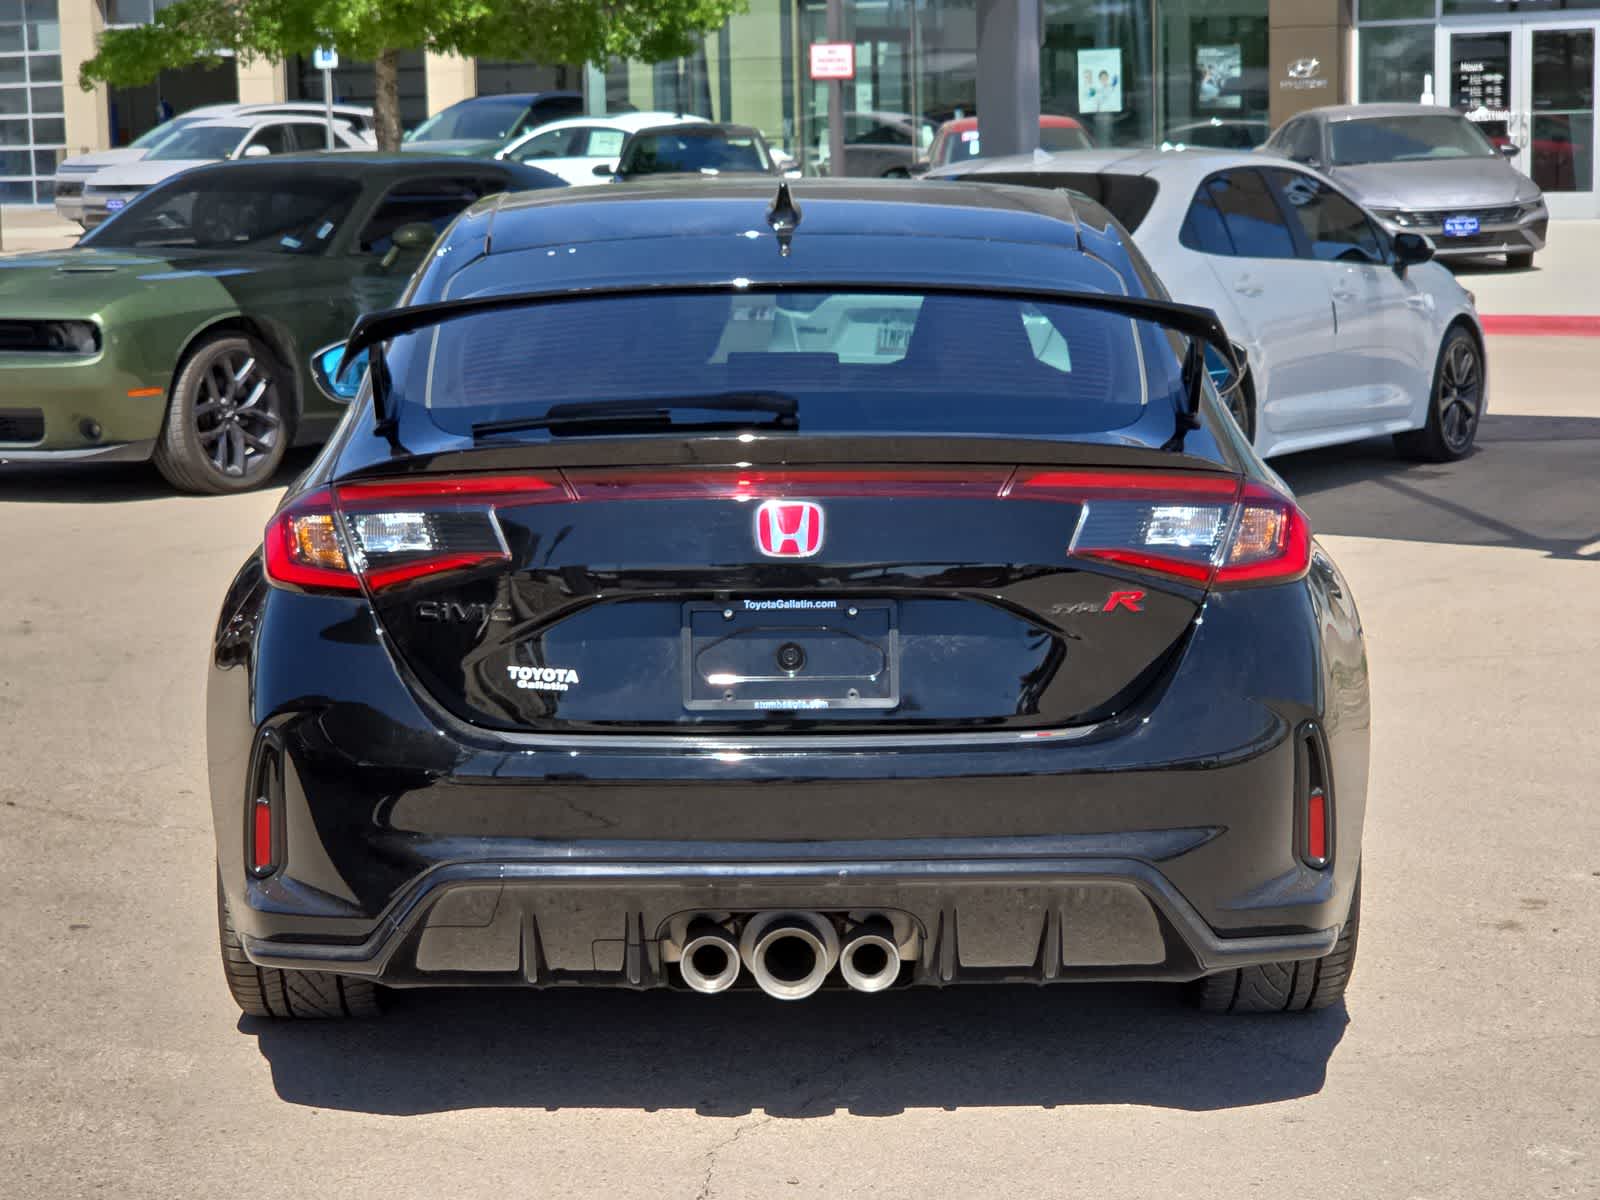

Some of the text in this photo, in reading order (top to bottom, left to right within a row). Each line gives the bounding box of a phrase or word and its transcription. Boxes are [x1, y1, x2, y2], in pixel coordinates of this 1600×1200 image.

[743, 599, 837, 611] ToyotaGallatin.com
[1103, 590, 1145, 612] R
[416, 601, 512, 622] CIVIC
[507, 666, 579, 683] TOYOTA
[516, 680, 569, 691] Gallatin
